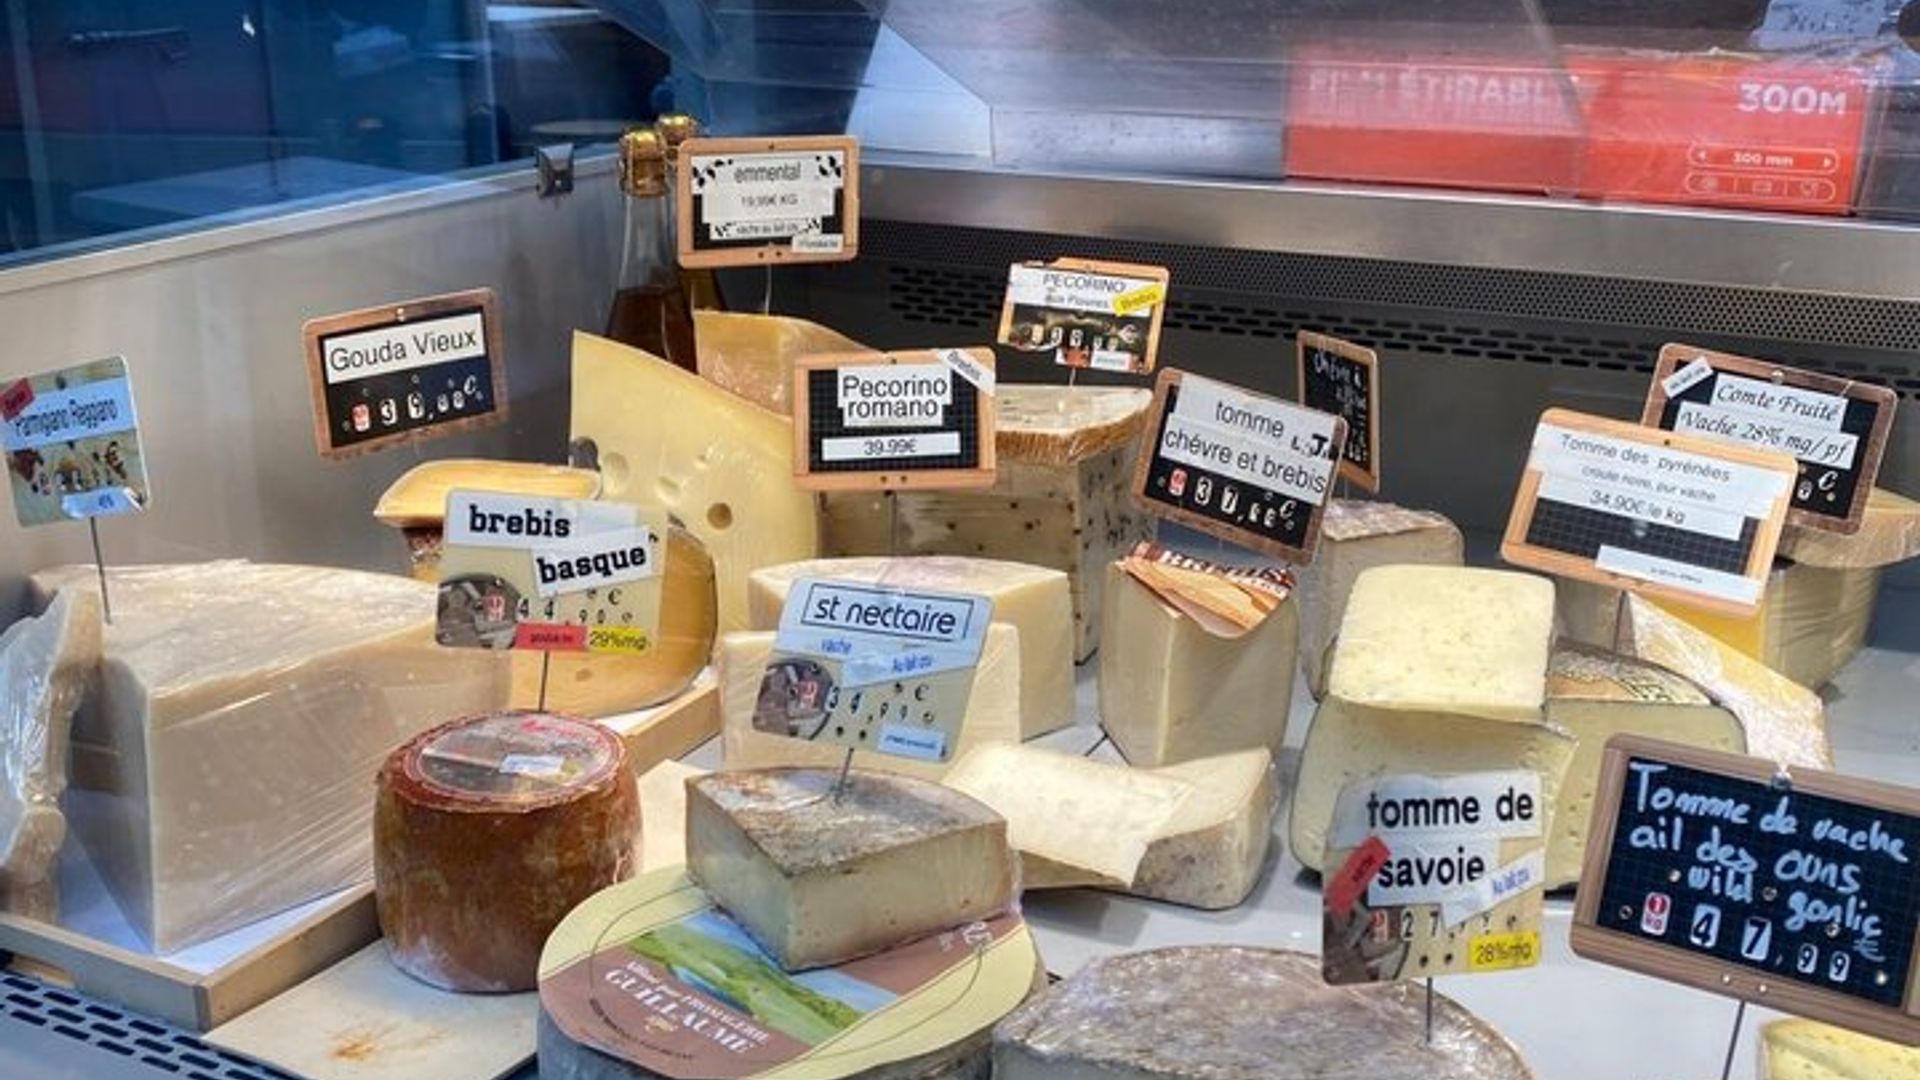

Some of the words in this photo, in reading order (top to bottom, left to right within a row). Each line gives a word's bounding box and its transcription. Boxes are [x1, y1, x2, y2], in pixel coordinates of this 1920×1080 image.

[1738, 82, 1848, 116] 300M
[734, 161, 801, 183] emmental
[1765, 154, 1795, 167] mm
[1042, 273, 1126, 293] PECORINO
[330, 339, 407, 371] Gouda
[413, 329, 477, 355] Vieux
[842, 374, 948, 398] Pecorino
[848, 398, 939, 418] romano
[1215, 399, 1284, 438] tomme
[1681, 411, 1738, 437] Vache
[1741, 422, 1784, 446] 28%
[1560, 434, 1618, 458] Tomme
[1621, 447, 1650, 465] des
[1237, 451, 1258, 472] et
[1262, 453, 1327, 493] brebis
[1679, 485, 1717, 502] vache
[469, 503, 571, 538] brebis
[1648, 503, 1663, 520] le
[1665, 506, 1686, 525] kg
[536, 545, 647, 585] basque
[815, 595, 842, 621] st
[845, 600, 958, 636] nectaire
[1366, 790, 1479, 829] tomme
[1496, 785, 1535, 822] de
[1629, 761, 1749, 825] Tomme
[1759, 796, 1799, 835] de
[1812, 818, 1910, 864] vache
[1629, 816, 1684, 851] ail
[1377, 845, 1486, 889] savoie
[1687, 864, 1755, 905] wild
[604, 968, 756, 1054] GUILLAUME
